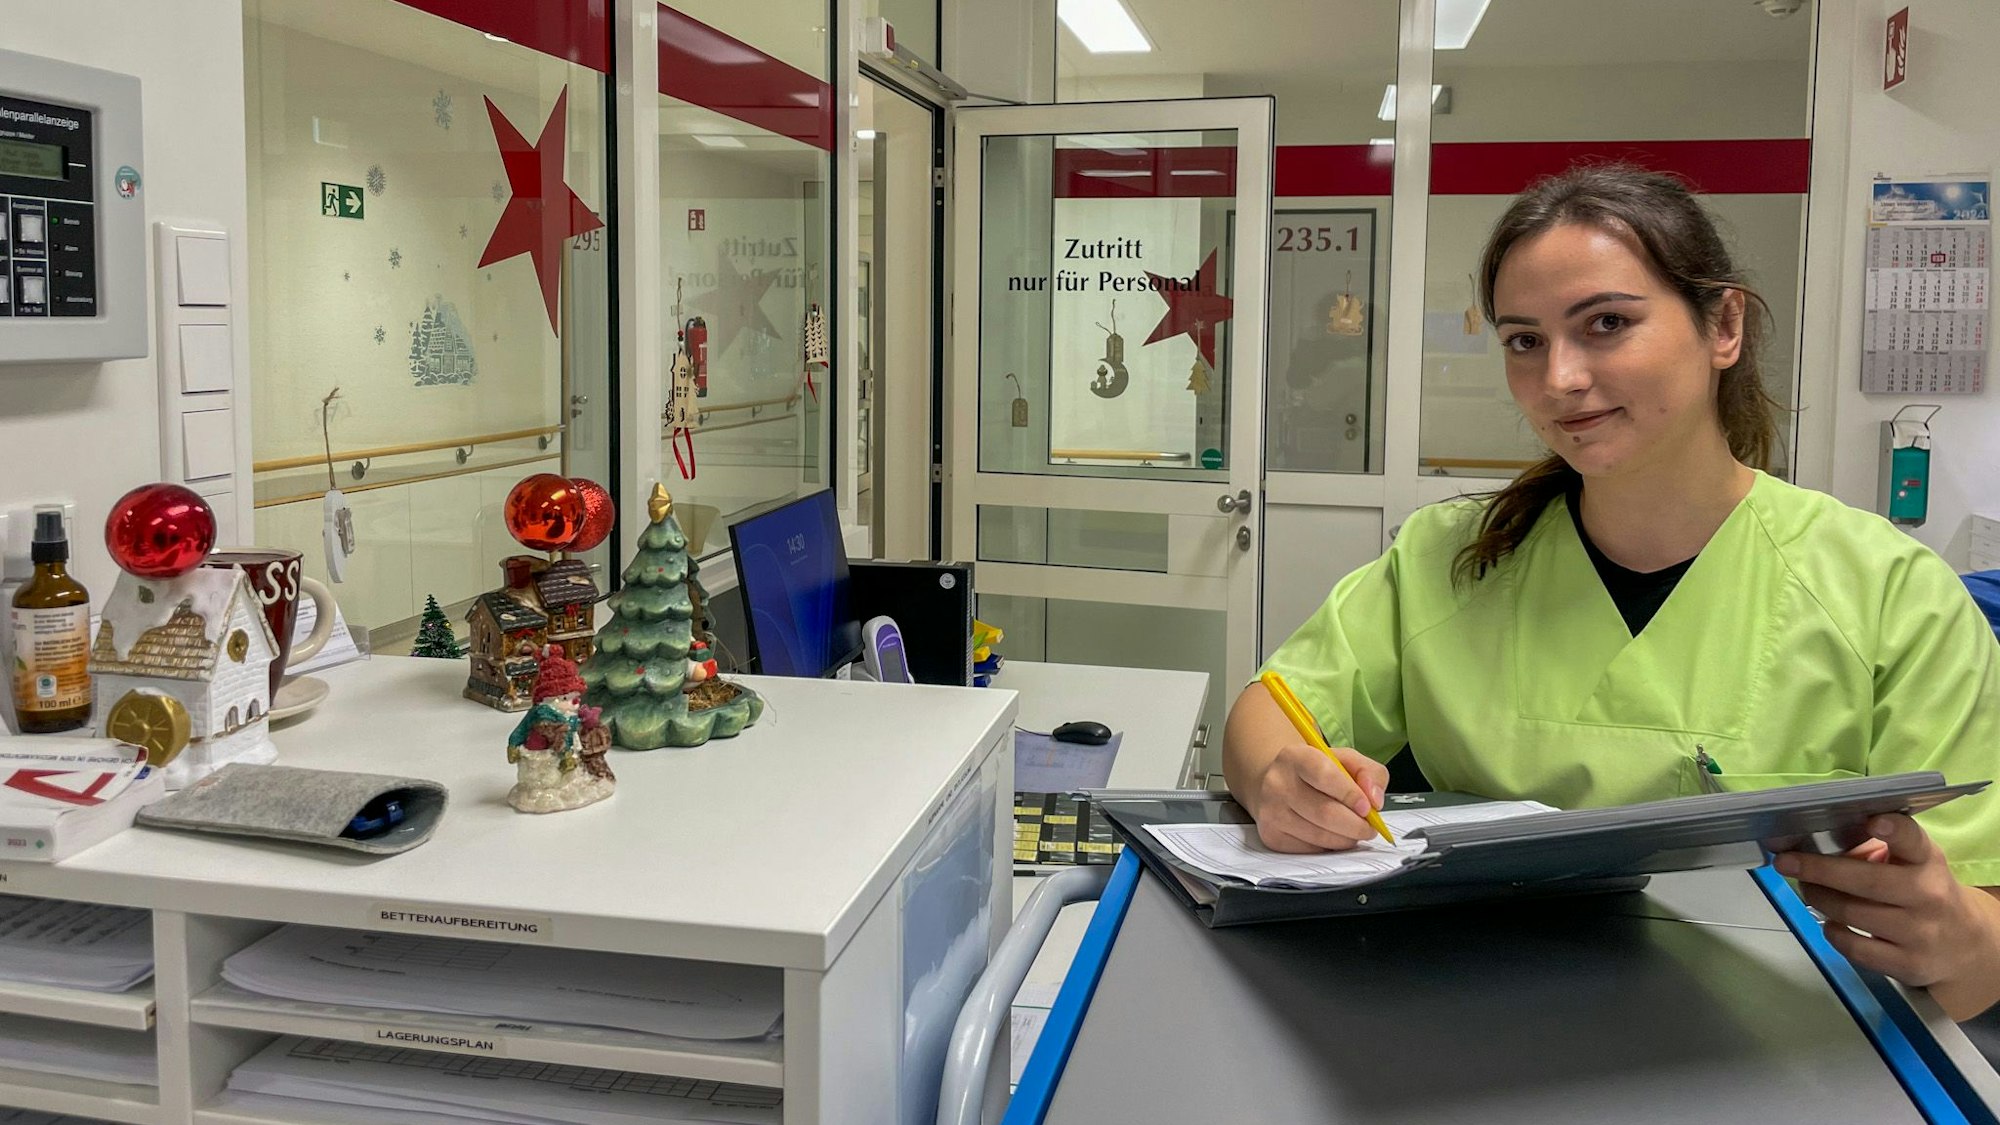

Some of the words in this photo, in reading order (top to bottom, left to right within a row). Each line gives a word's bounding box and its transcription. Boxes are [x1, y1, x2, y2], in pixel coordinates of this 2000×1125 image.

[0, 107, 79, 130] lenparallelanzeige
[1953, 209, 1986, 220] 2024
[573, 230, 600, 252] 295
[1064, 237, 1143, 259] Zutritt
[1277, 226, 1358, 252] 235.1
[1008, 276, 1047, 291] nur
[1056, 270, 1089, 291] für
[1099, 270, 1201, 291] Personal
[39, 700, 57, 709] 100
[59, 698, 72, 707] ml
[381, 910, 538, 933] BETTENAUFBEREITUNG
[377, 1029, 494, 1050] LAGERUNGSPLAN
